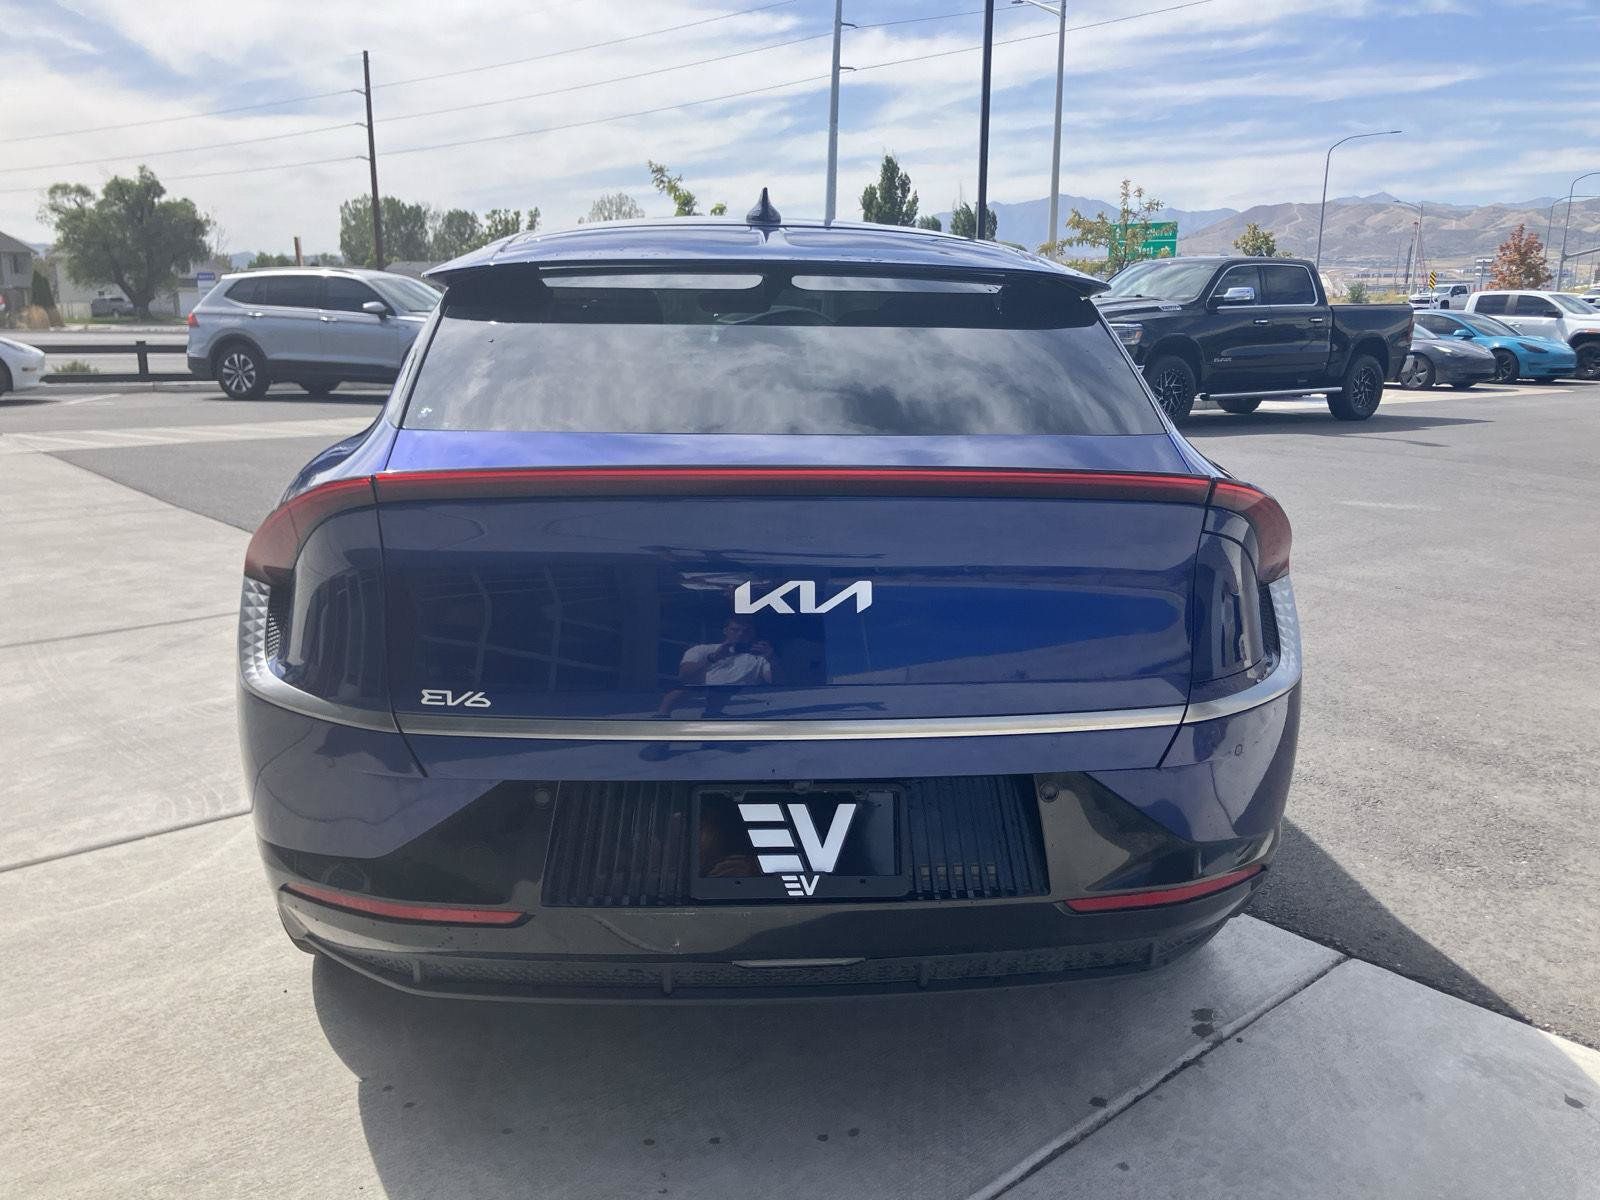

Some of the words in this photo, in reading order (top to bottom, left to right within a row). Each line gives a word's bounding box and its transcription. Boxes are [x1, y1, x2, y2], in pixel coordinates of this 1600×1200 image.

[734, 580, 873, 614] KIA
[420, 689, 492, 708] EV6
[737, 803, 857, 874] EV
[781, 875, 820, 896] EV
